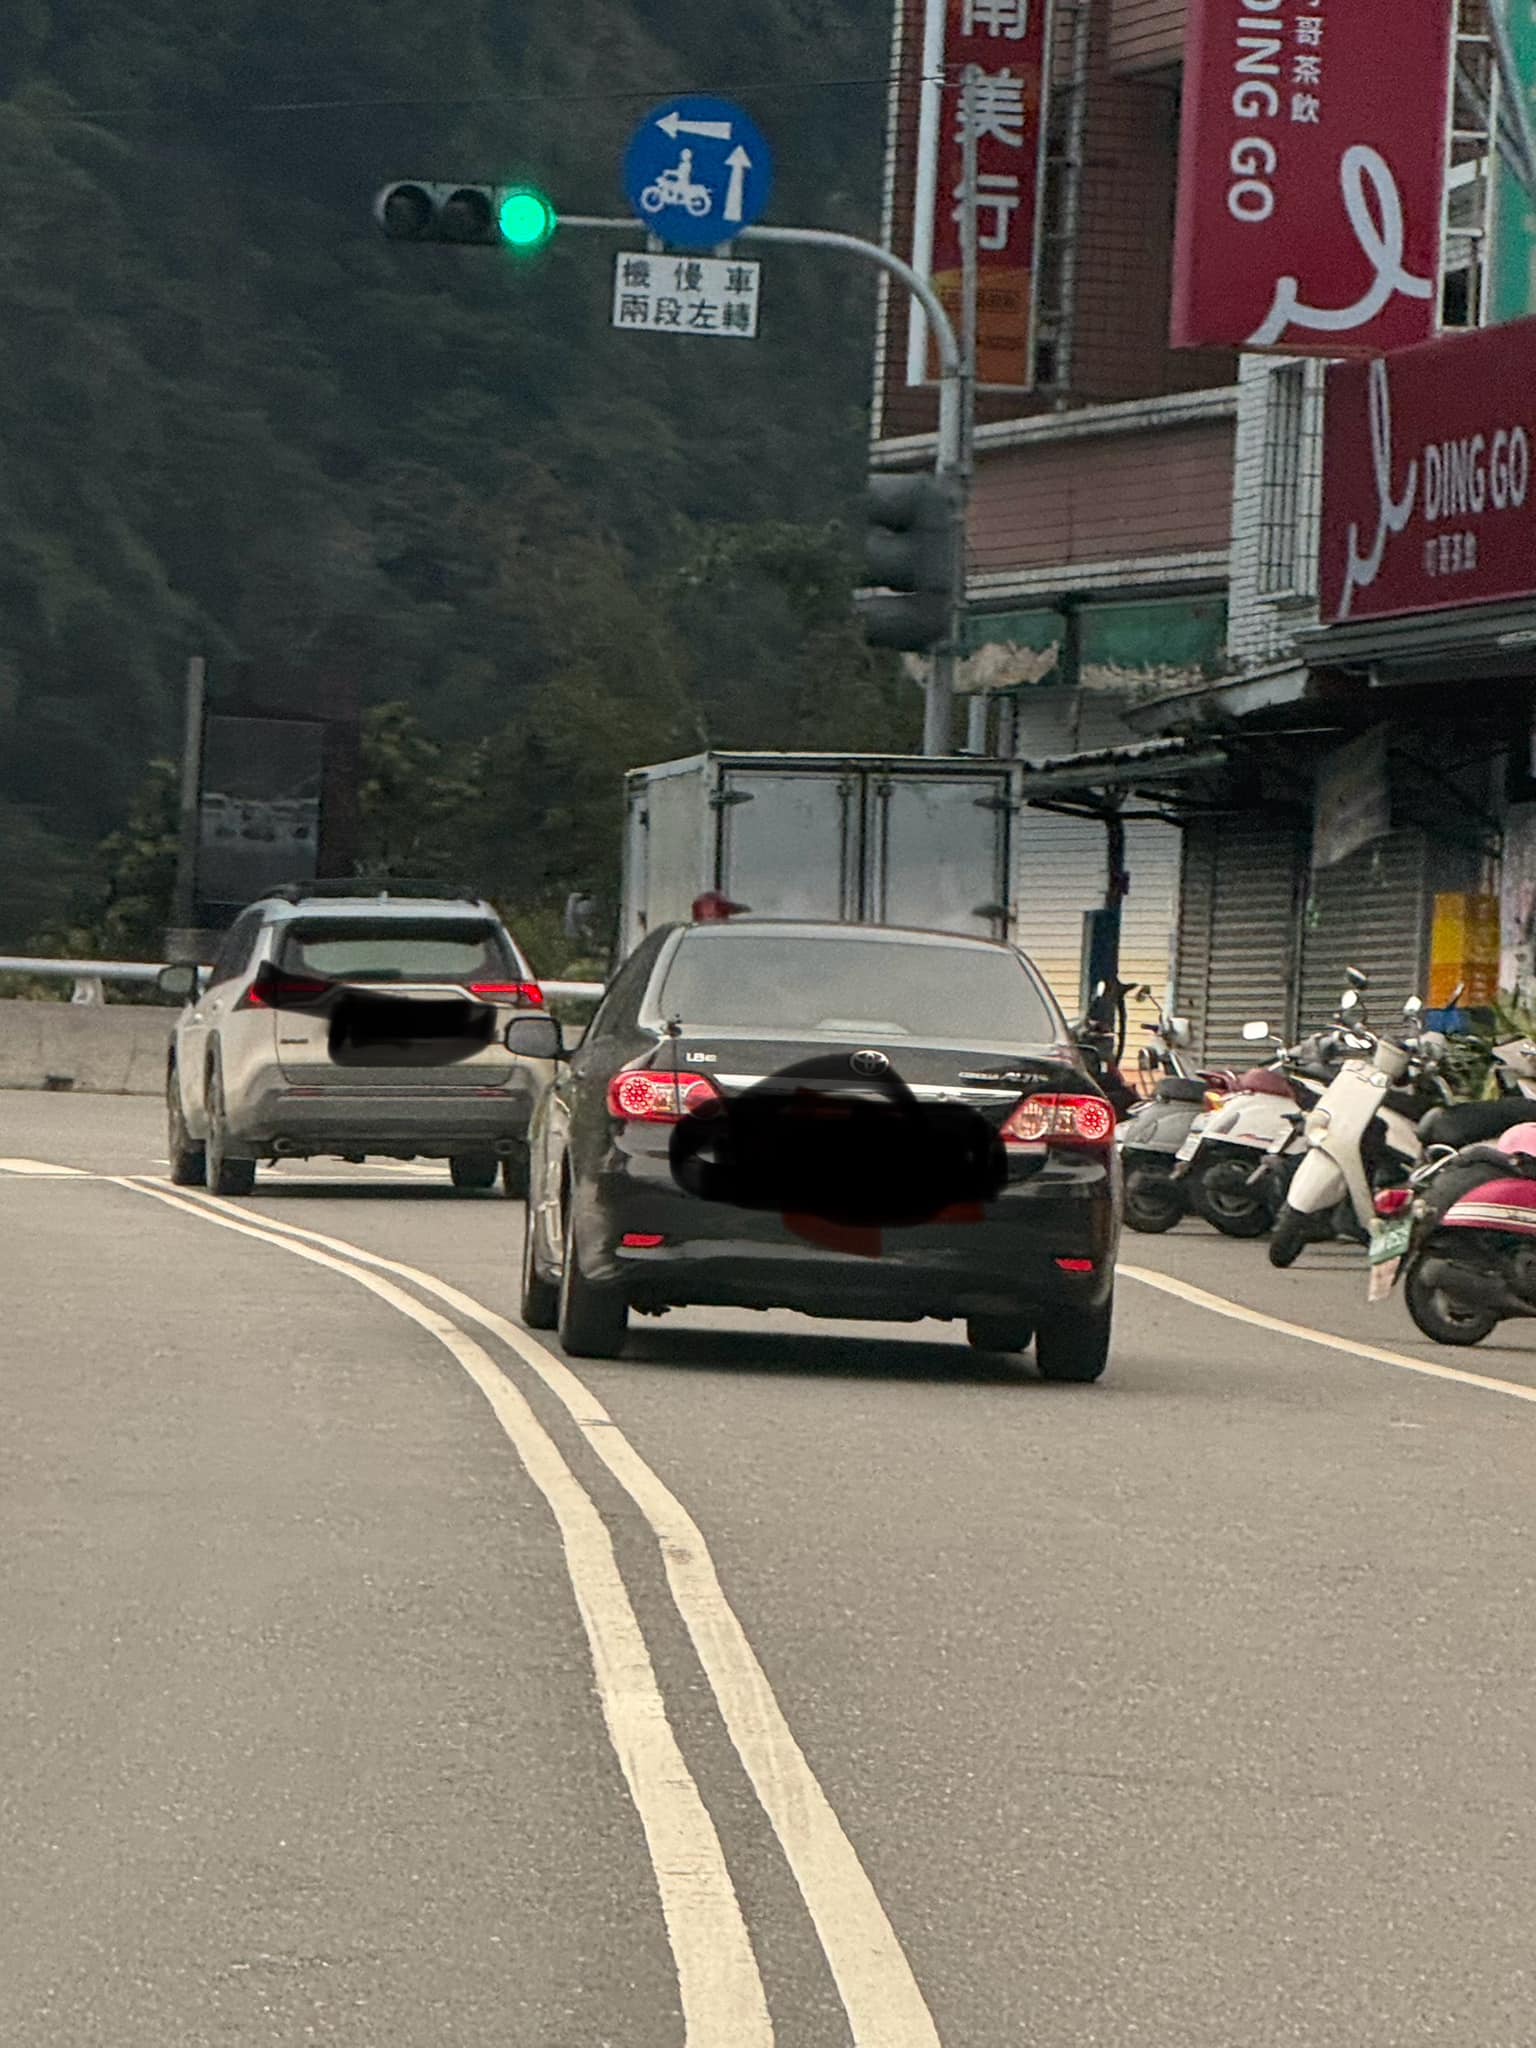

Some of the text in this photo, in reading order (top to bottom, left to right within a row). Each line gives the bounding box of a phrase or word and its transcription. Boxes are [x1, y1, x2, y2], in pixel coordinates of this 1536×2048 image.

[1290, 0, 1324, 125] 哥茶飲
[1228, 136, 1277, 223] GO
[620, 294, 751, 332] 兩段左轉
[623, 258, 754, 295] 機慢車
[1424, 426, 1528, 522] DING GO
